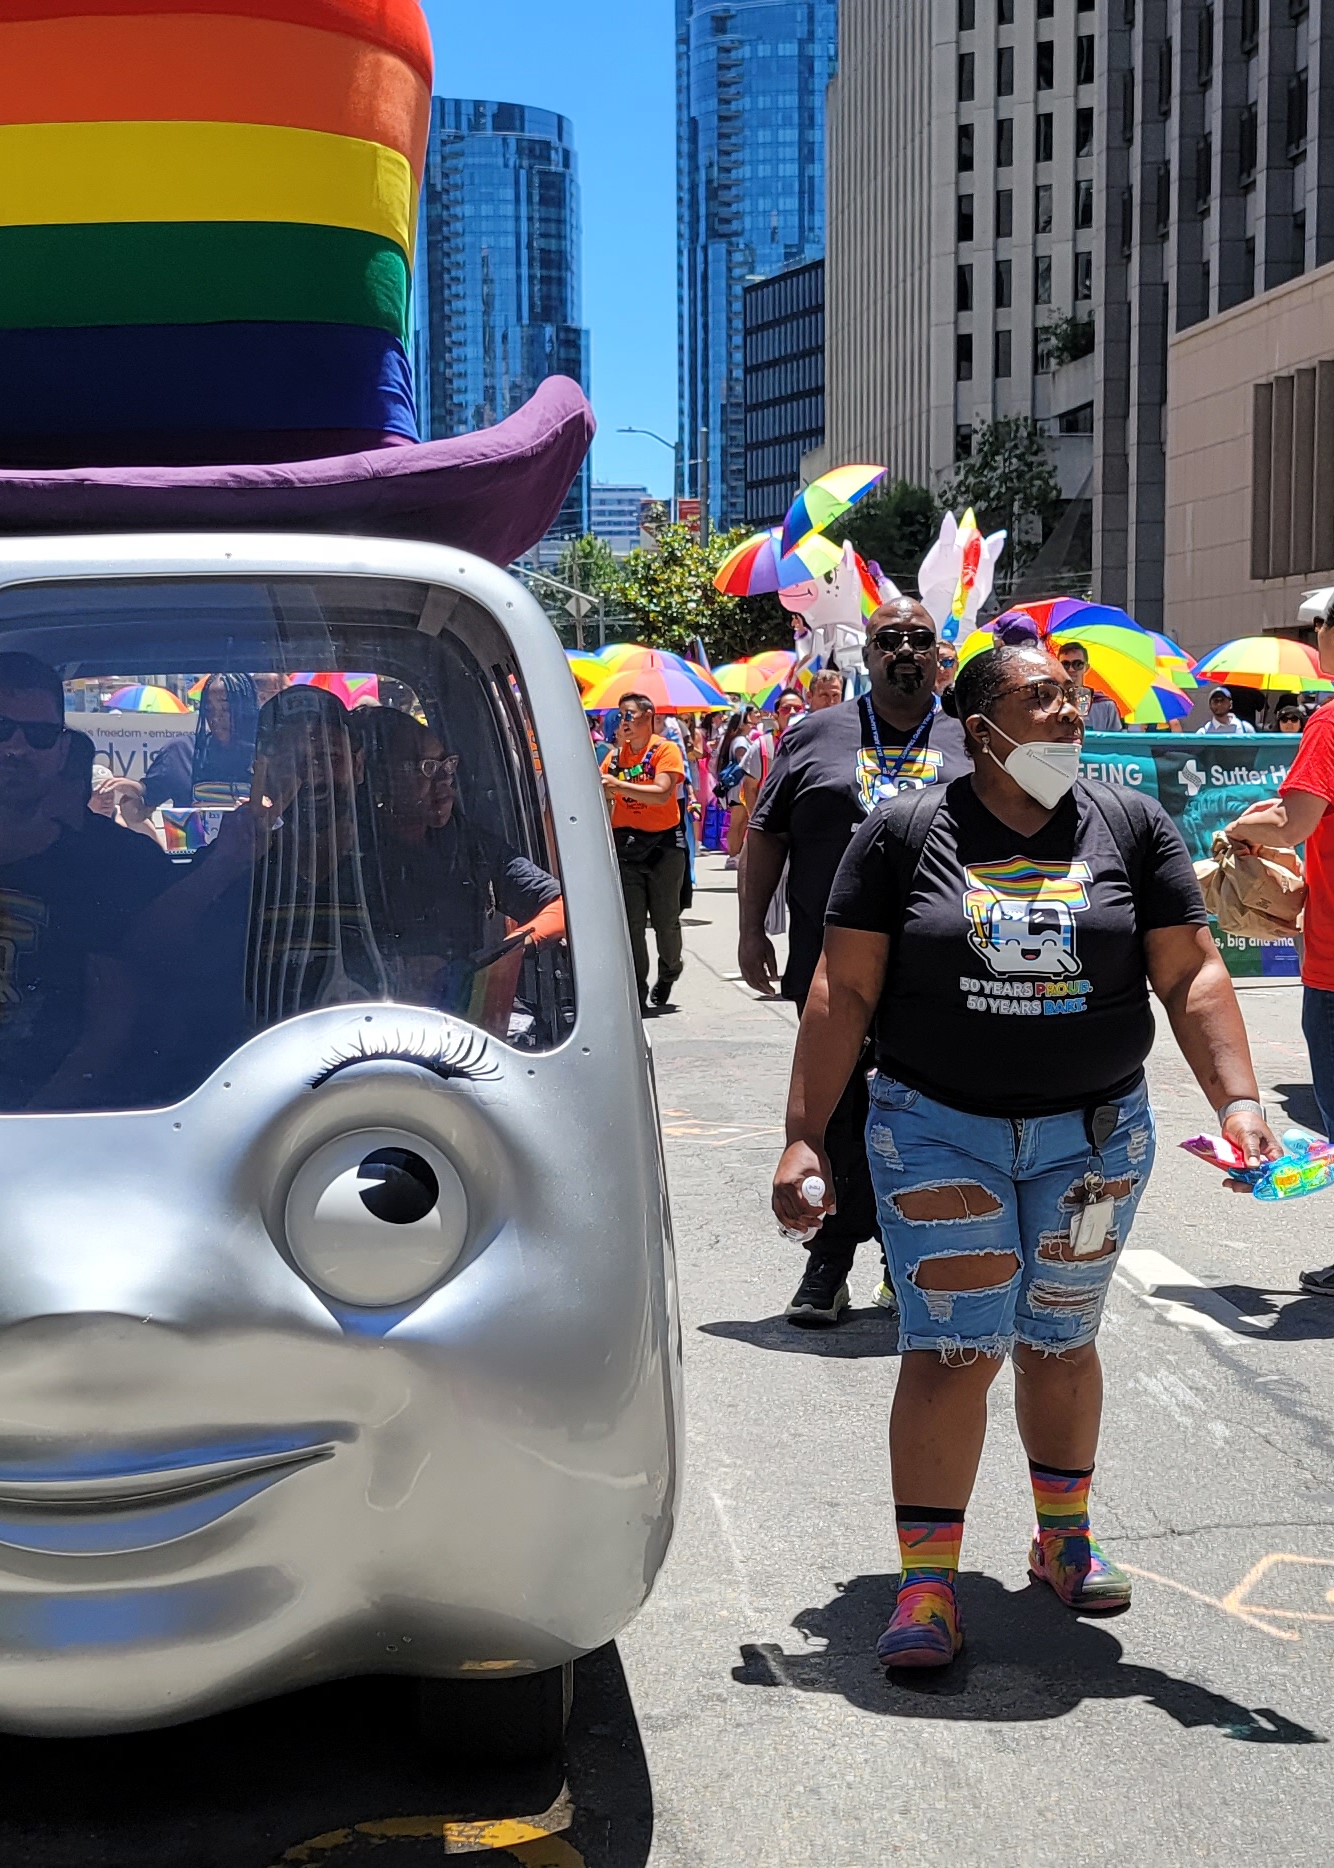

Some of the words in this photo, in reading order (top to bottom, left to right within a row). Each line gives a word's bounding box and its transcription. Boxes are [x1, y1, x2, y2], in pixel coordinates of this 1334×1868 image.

[97, 728, 142, 738] freedom
[1210, 765, 1269, 786] Sutter
[1269, 765, 1289, 785] H
[1227, 934, 1246, 950] big
[960, 977, 981, 992] 50
[980, 979, 1033, 998] YEARS
[1035, 979, 1094, 998] PROUD.
[967, 995, 988, 1012] 50
[987, 998, 1042, 1015] YEARS
[1043, 997, 1088, 1016] BART.
